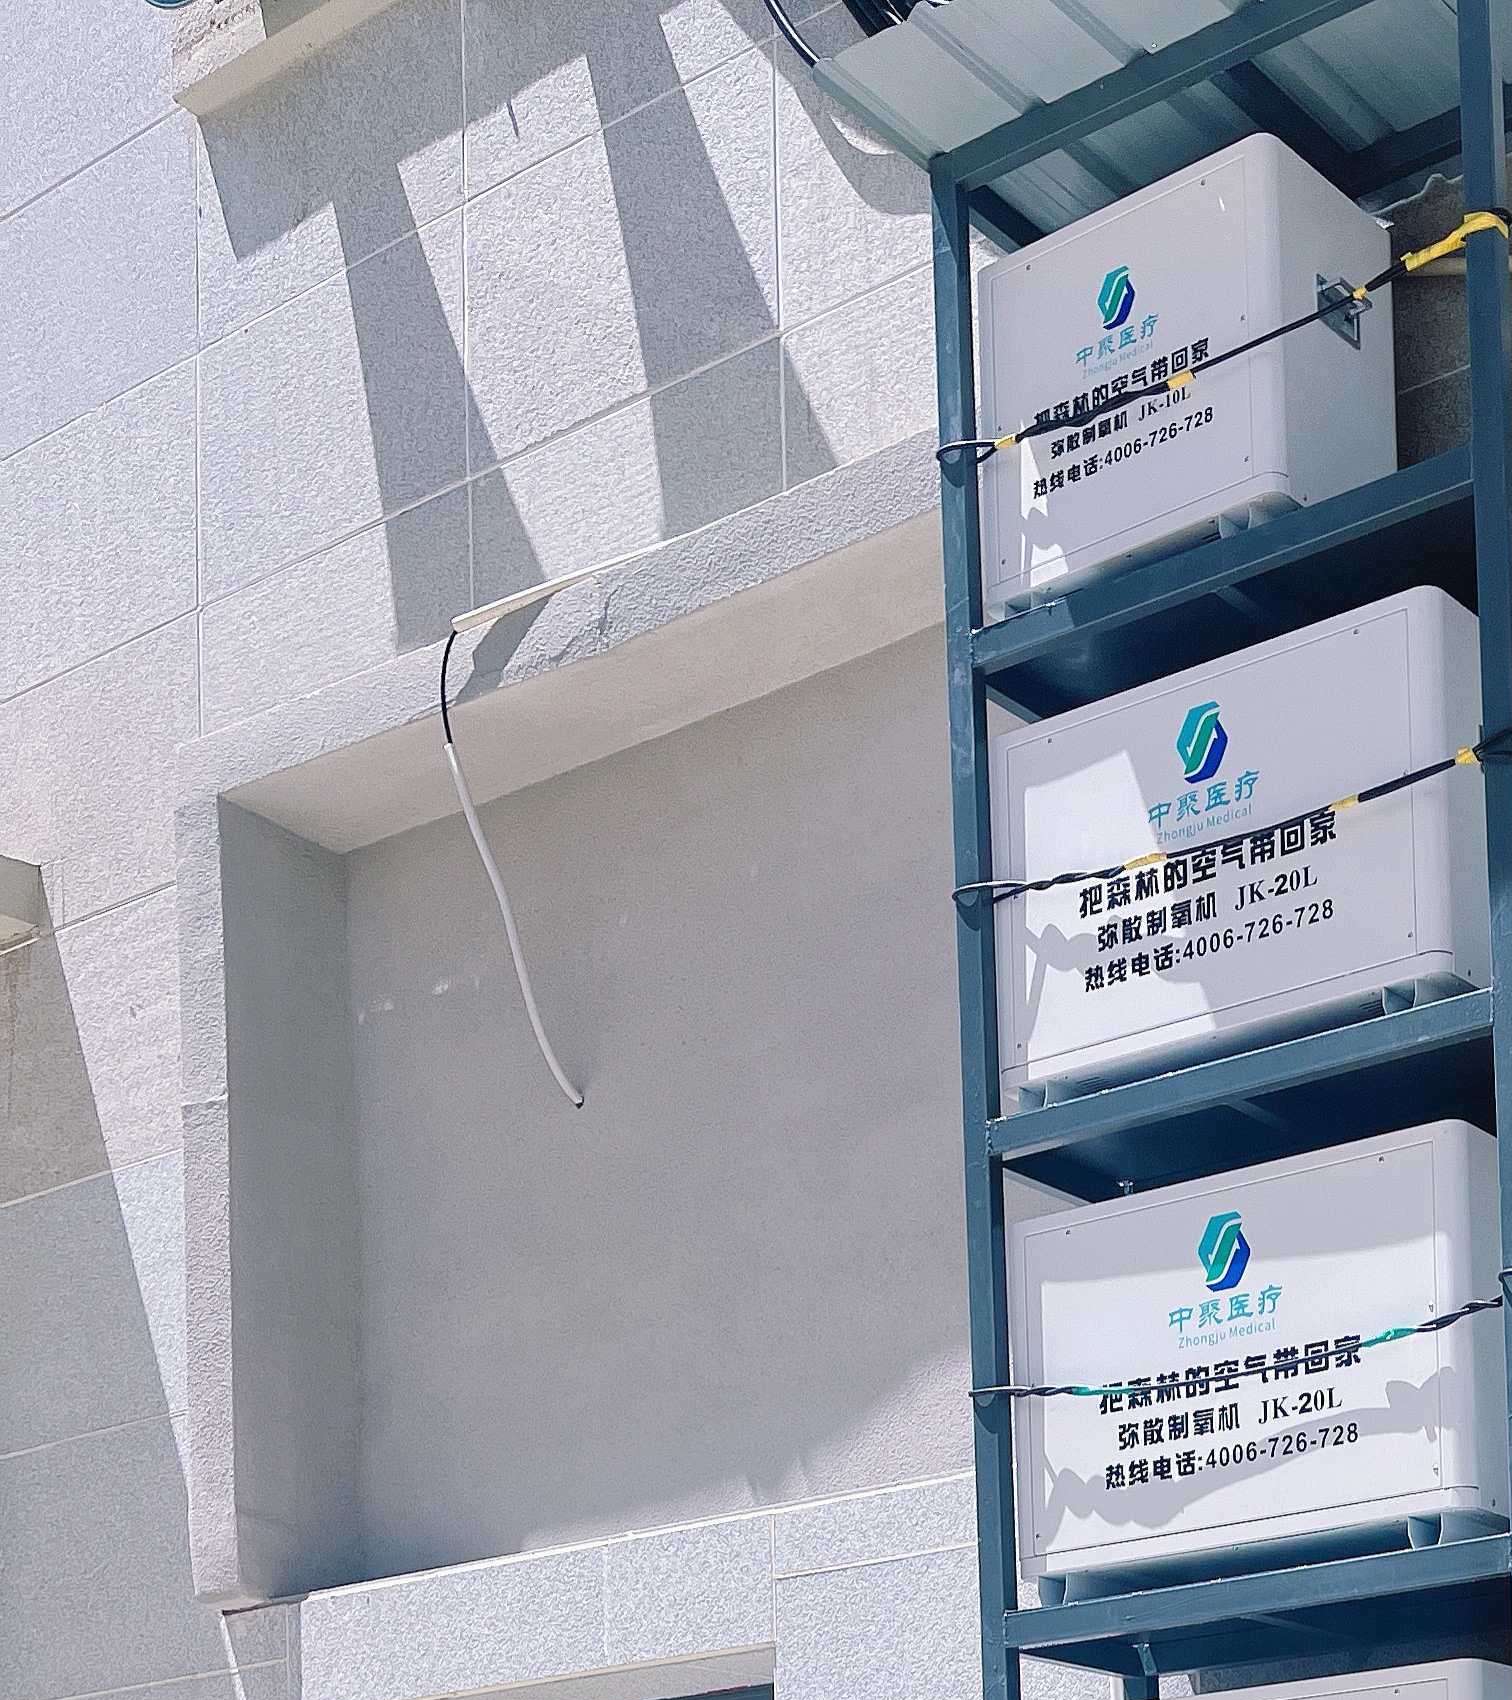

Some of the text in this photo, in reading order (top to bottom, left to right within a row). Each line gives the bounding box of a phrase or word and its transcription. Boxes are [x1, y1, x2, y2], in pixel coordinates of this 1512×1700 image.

[1137, 385, 1192, 422] JK-10L
[1147, 769, 1260, 829] 中聚医疗
[1156, 802, 1252, 844] Zhongju Medical
[1078, 809, 1337, 919] 把森林的空气带回家
[1097, 864, 1319, 952] 弥散制氧机 JK-20L
[1167, 1283, 1283, 1334] 中聚医疗
[1177, 1318, 1276, 1350] Zhongju Medical
[1117, 1386, 1343, 1451] 弥散制氧机 JK-20L
